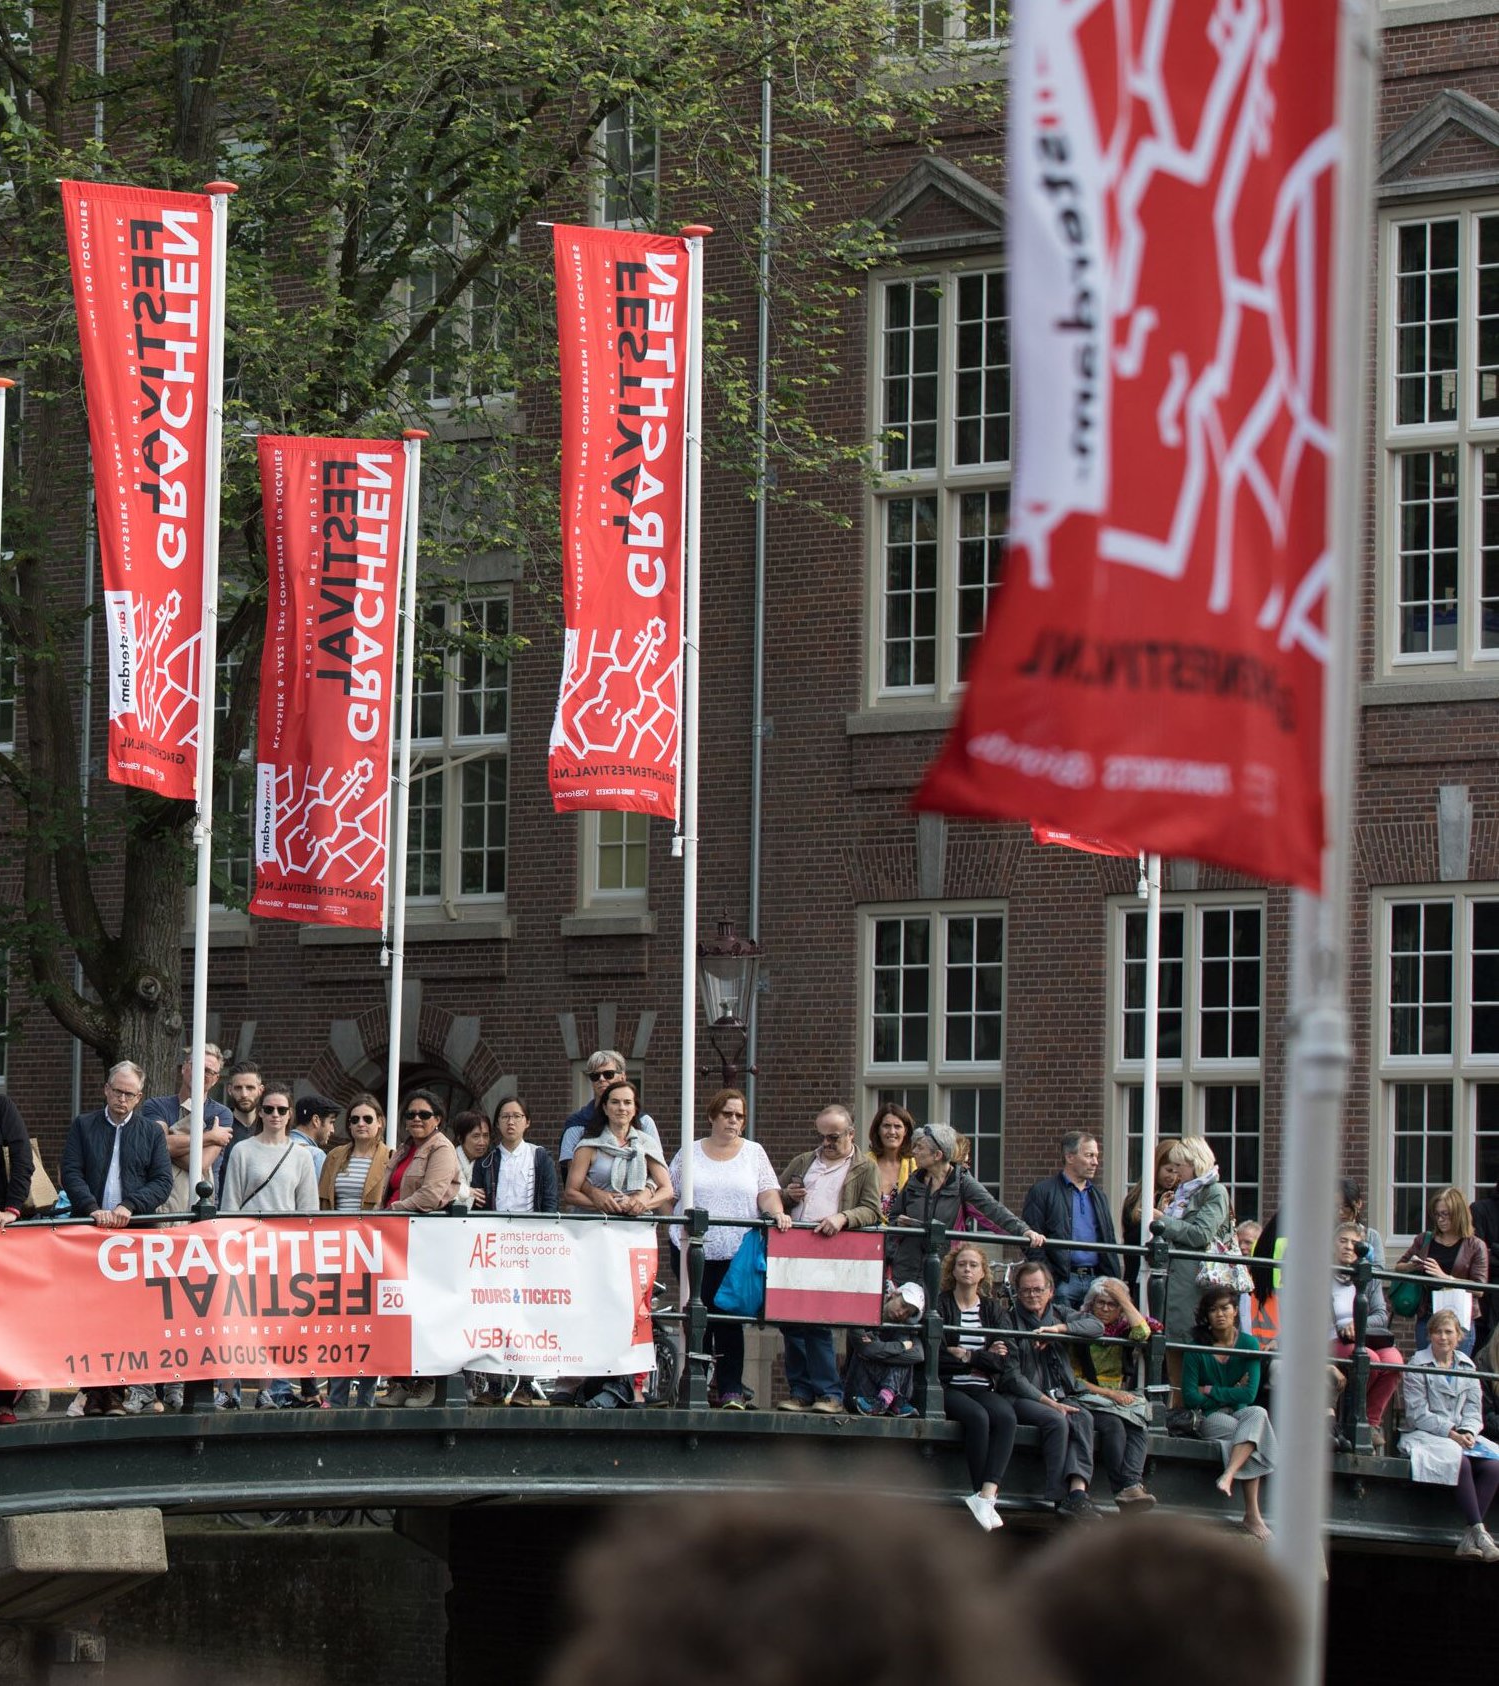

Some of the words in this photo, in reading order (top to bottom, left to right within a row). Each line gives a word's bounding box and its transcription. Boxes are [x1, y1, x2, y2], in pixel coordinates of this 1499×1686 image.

[500, 1232, 565, 1243] amsterdams
[97, 1230, 384, 1282] GRACHTEN
[500, 1245, 530, 1256] fonds
[532, 1247, 556, 1256] voor
[558, 1245, 571, 1256] de
[500, 1258, 530, 1269] kunst
[145, 1272, 372, 1320] FESTIVAL
[382, 1293, 404, 1309] 20
[471, 1288, 512, 1305] TOURS
[513, 1288, 520, 1304] &
[522, 1288, 572, 1305] TICKETS
[164, 1326, 239, 1338] BEGINT
[251, 1326, 283, 1335] MET
[301, 1325, 372, 1334] MUZIEK
[66, 1354, 92, 1374] 11
[101, 1350, 149, 1372] T/M
[160, 1348, 189, 1369] 20
[200, 1345, 309, 1367] AUGUSTUS
[317, 1344, 371, 1365] 2017
[503, 1352, 541, 1363] iedereen
[543, 1353, 561, 1363] doet
[563, 1355, 584, 1363] mee
